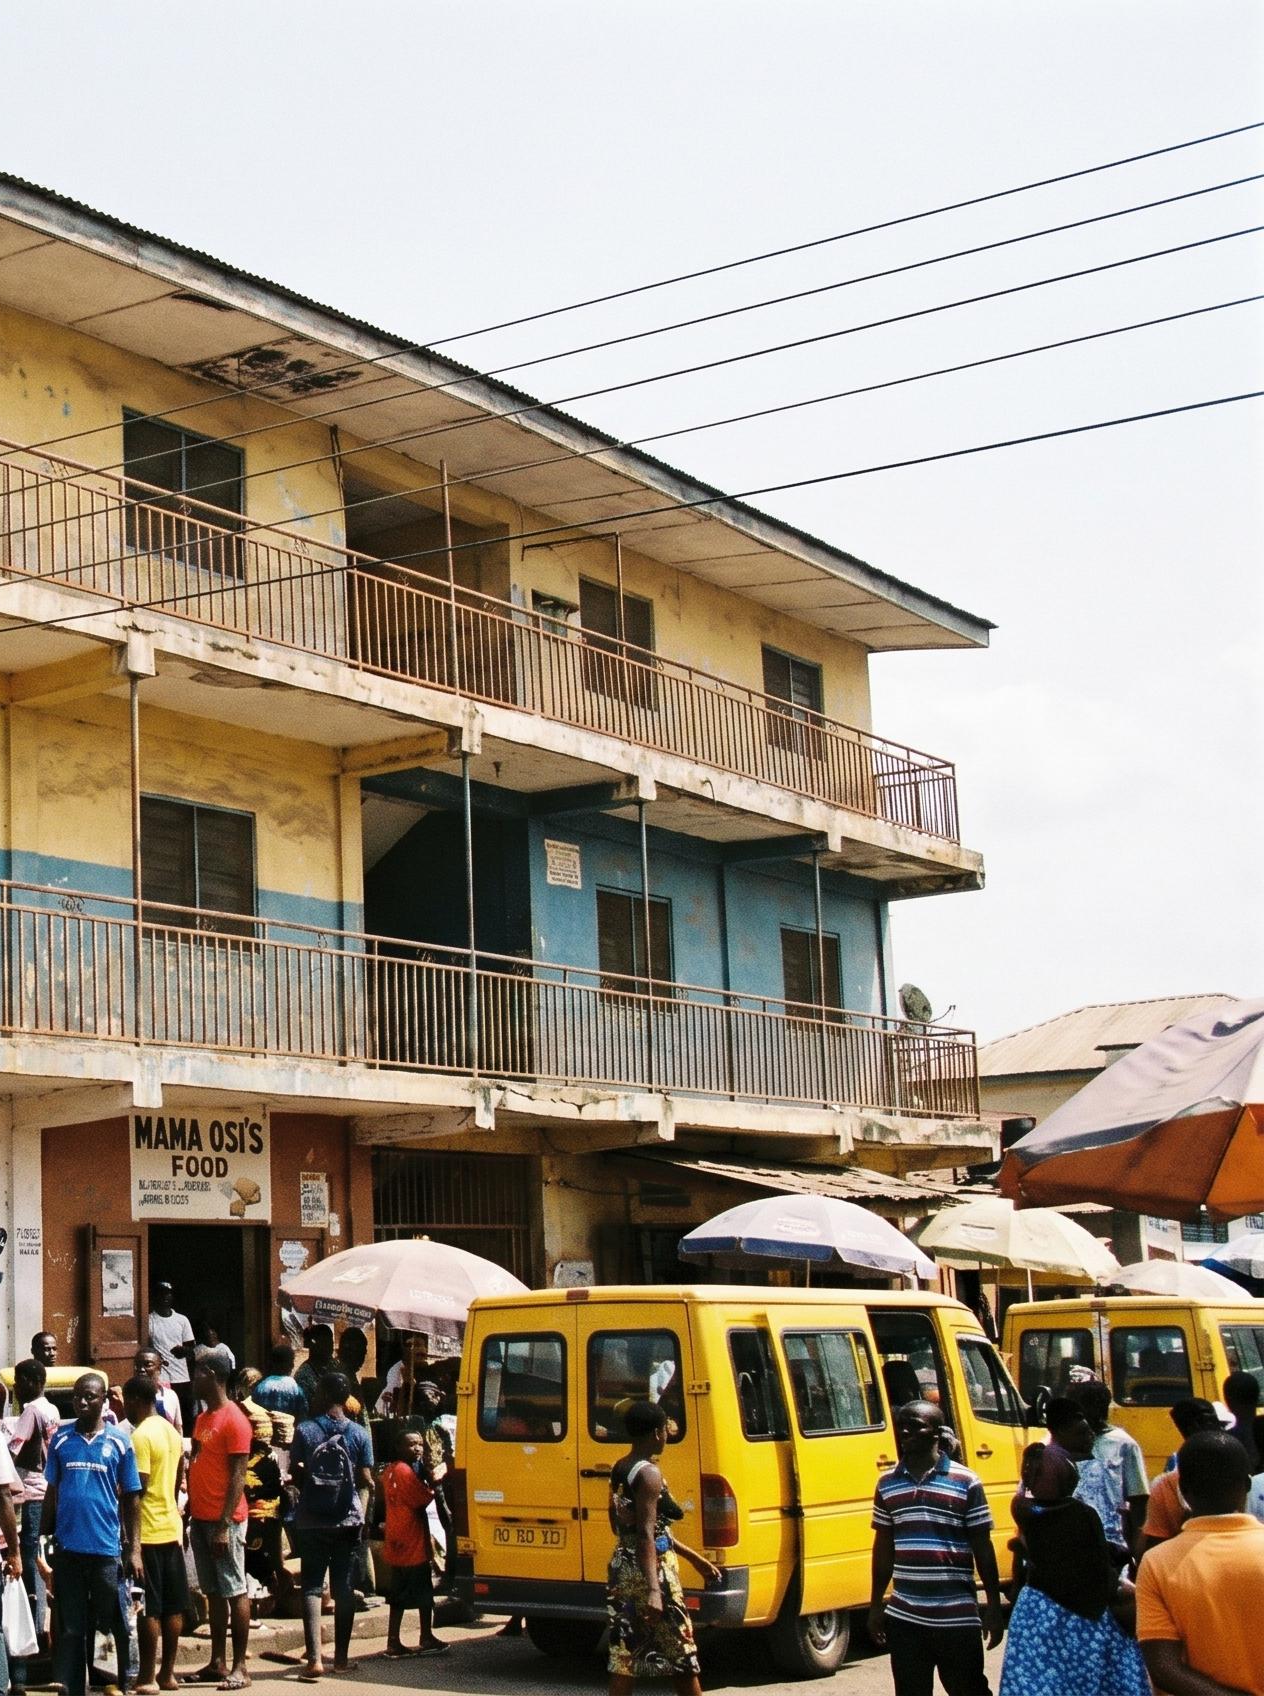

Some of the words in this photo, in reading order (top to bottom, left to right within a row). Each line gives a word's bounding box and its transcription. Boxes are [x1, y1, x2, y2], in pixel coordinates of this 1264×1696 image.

[134, 1115, 203, 1152] MAMA
[209, 1116, 264, 1155] OSI'S
[171, 1155, 229, 1178] FOOD
